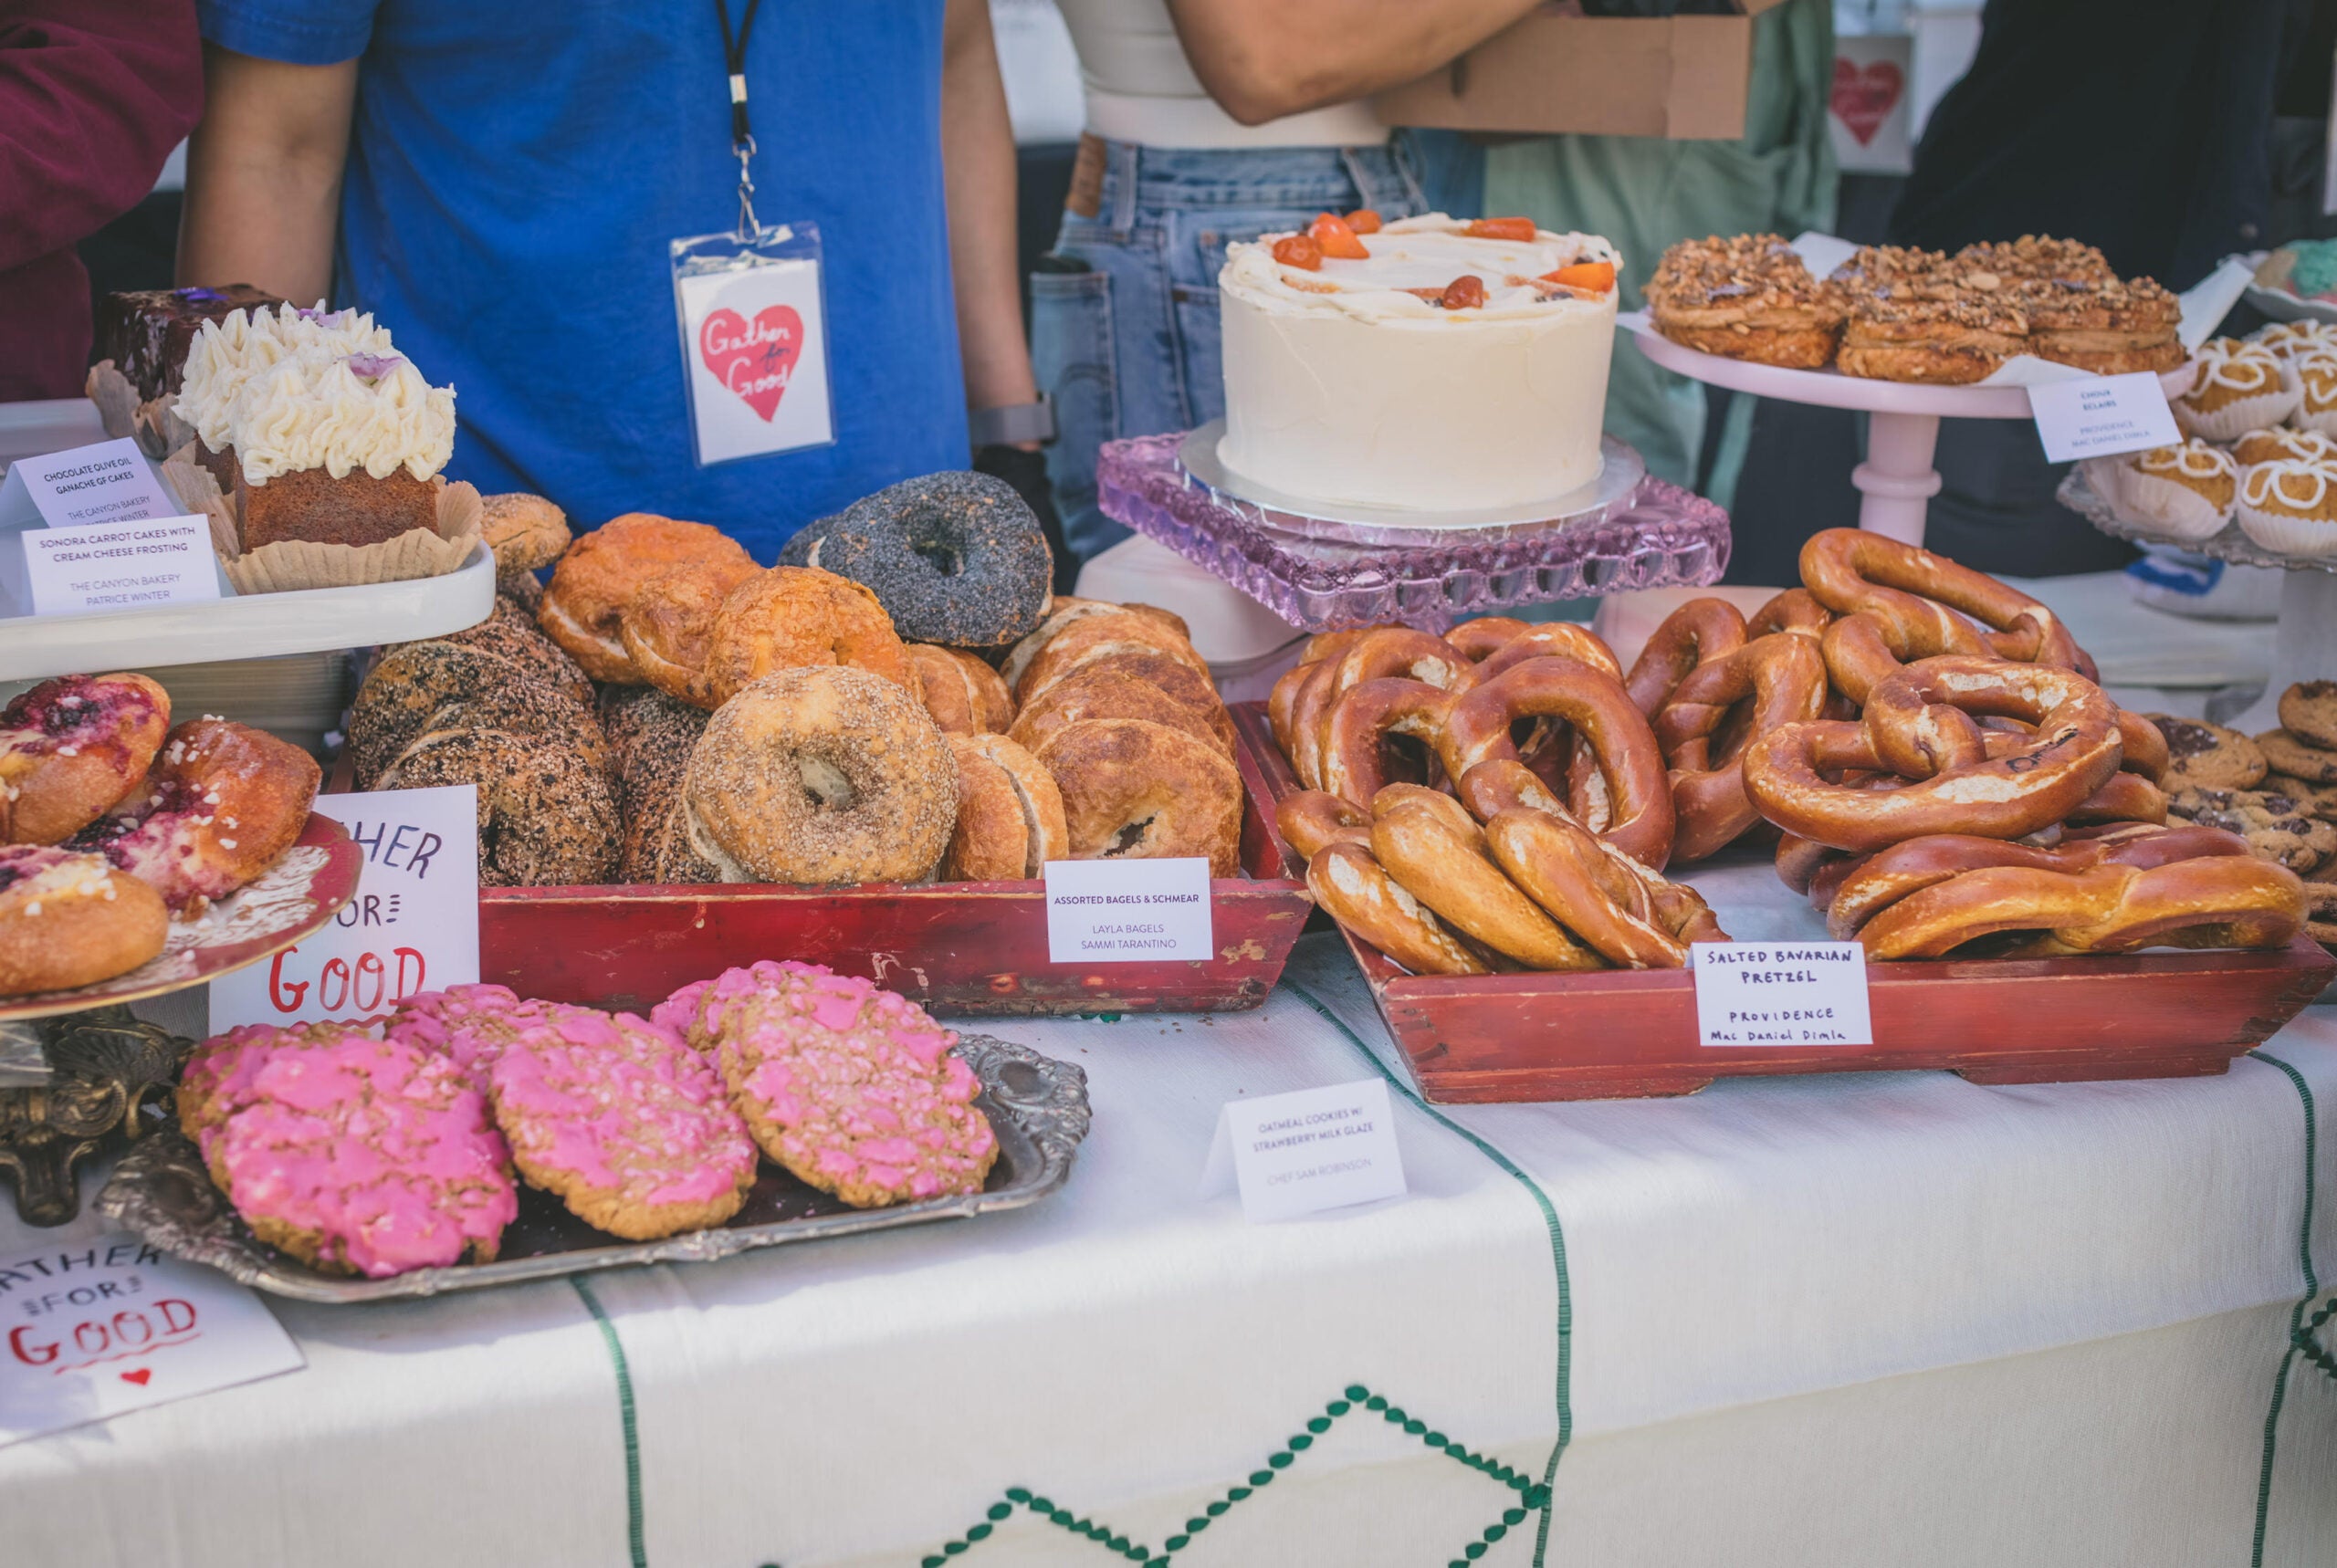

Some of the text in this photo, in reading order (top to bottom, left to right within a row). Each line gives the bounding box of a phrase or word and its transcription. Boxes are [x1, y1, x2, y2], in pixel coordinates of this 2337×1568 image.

[728, 356, 790, 397] Good
[44, 457, 132, 483] CHOCOLATE OLIVE OIL
[56, 471, 134, 495] GANACHE GF CAKES
[68, 496, 151, 520] THE CANYON BAKERY
[119, 509, 150, 522] WINTER
[39, 527, 196, 549] SONORA CARROT CAKES WITH
[53, 543, 189, 562] CREAM CHEESE FROSTING
[70, 573, 182, 591] THE CANYON BAKERY
[87, 591, 171, 606] PATRICE WINTER
[351, 821, 443, 879] HER
[336, 894, 382, 927] OR
[1053, 894, 1200, 905] ASSORTED BAGELS & SCHMEAR
[1093, 924, 1164, 935] LAYLA BAGELS
[1081, 939, 1177, 950] SAMMI TARANTINO
[1707, 949, 1852, 964] SALTED BAVARIAN
[268, 945, 426, 1013] GOOD
[1741, 970, 1818, 984] PRETZEL
[1729, 1008, 1834, 1023] PROVIDENCE
[1711, 1030, 1847, 1040] Mac Daniel Dimla
[1258, 1119, 1304, 1134] OATMEAL
[1305, 1109, 1349, 1125] COOKIES
[1253, 1122, 1374, 1153] STRAWBERRY MILK GLAZE
[1267, 1158, 1372, 1186] CHEF SAM ROBINSON
[0, 1243, 162, 1291] ATHER
[41, 1281, 126, 1312] FOR
[8, 1299, 197, 1366] GOOD
